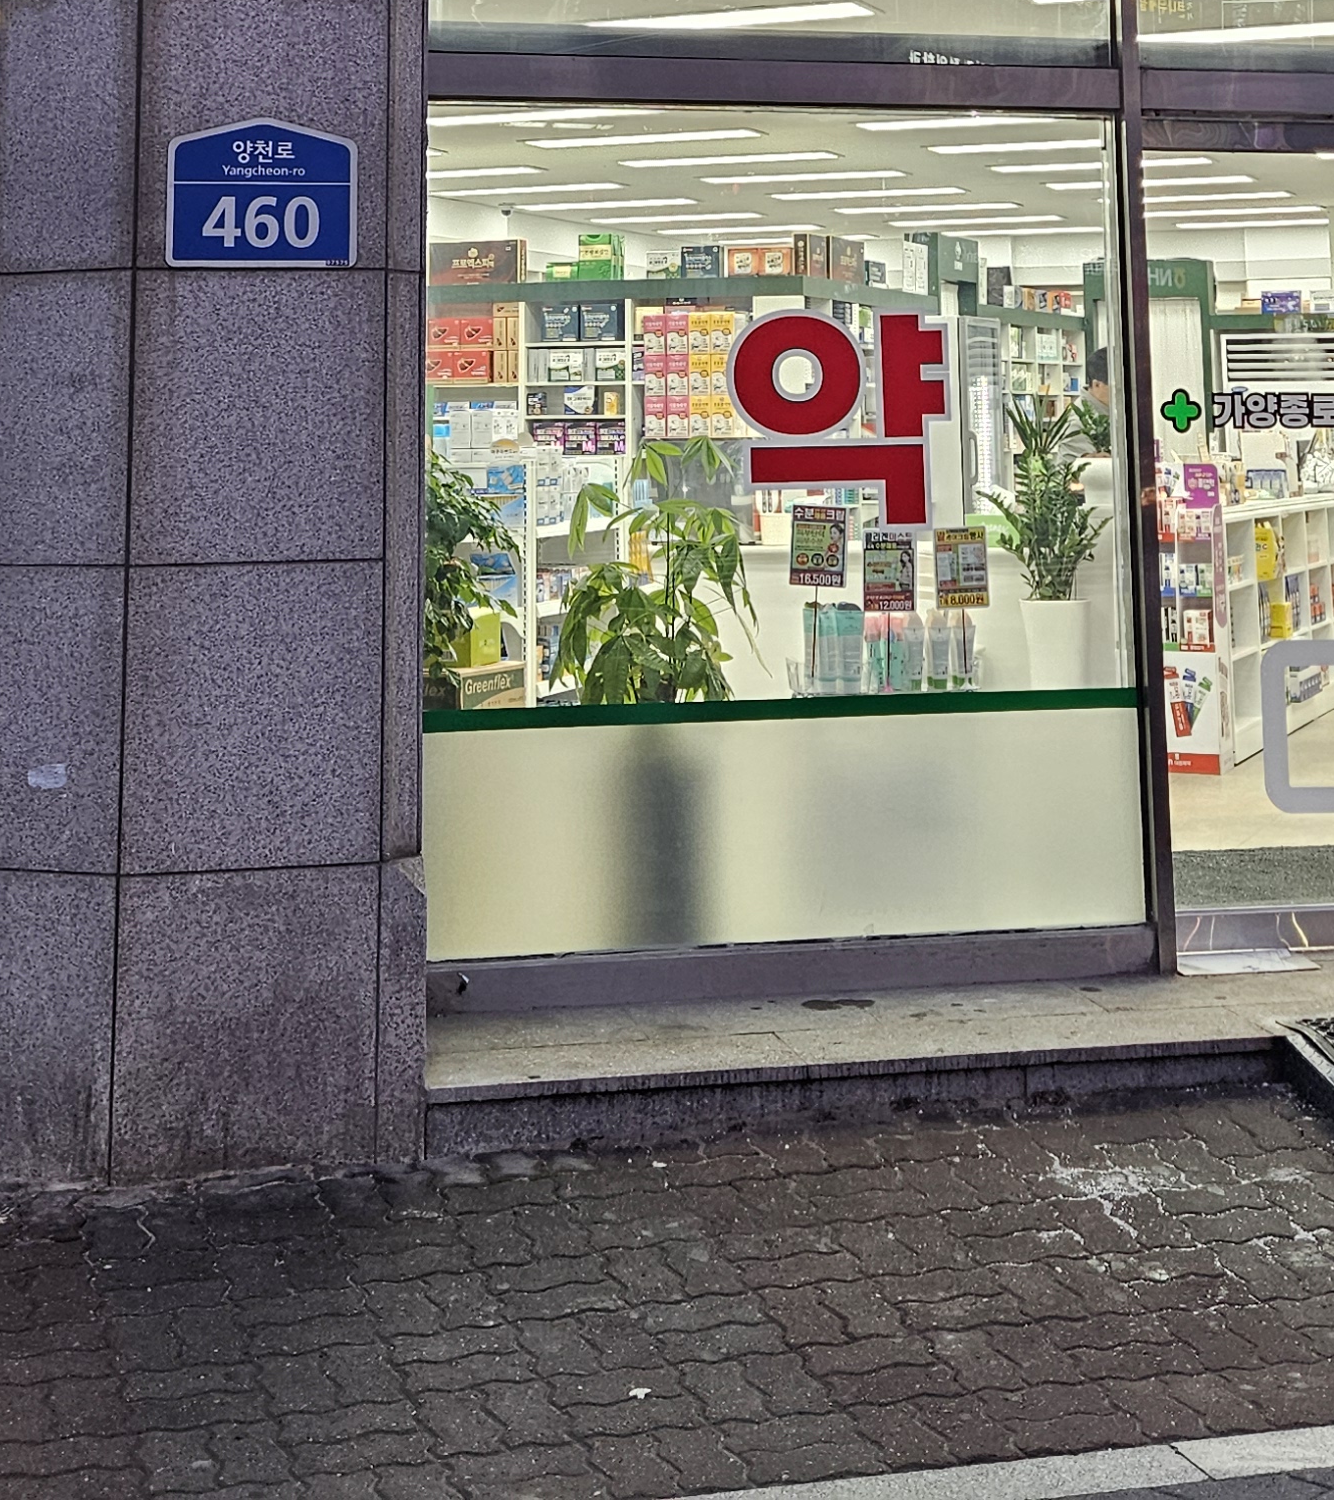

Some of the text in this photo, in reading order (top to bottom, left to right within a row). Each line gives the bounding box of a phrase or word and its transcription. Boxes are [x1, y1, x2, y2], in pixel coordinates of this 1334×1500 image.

[232, 140, 296, 163] 양천로
[222, 164, 306, 179] Yangcheon-ro
[202, 196, 320, 249] 460
[726, 307, 951, 531] 약
